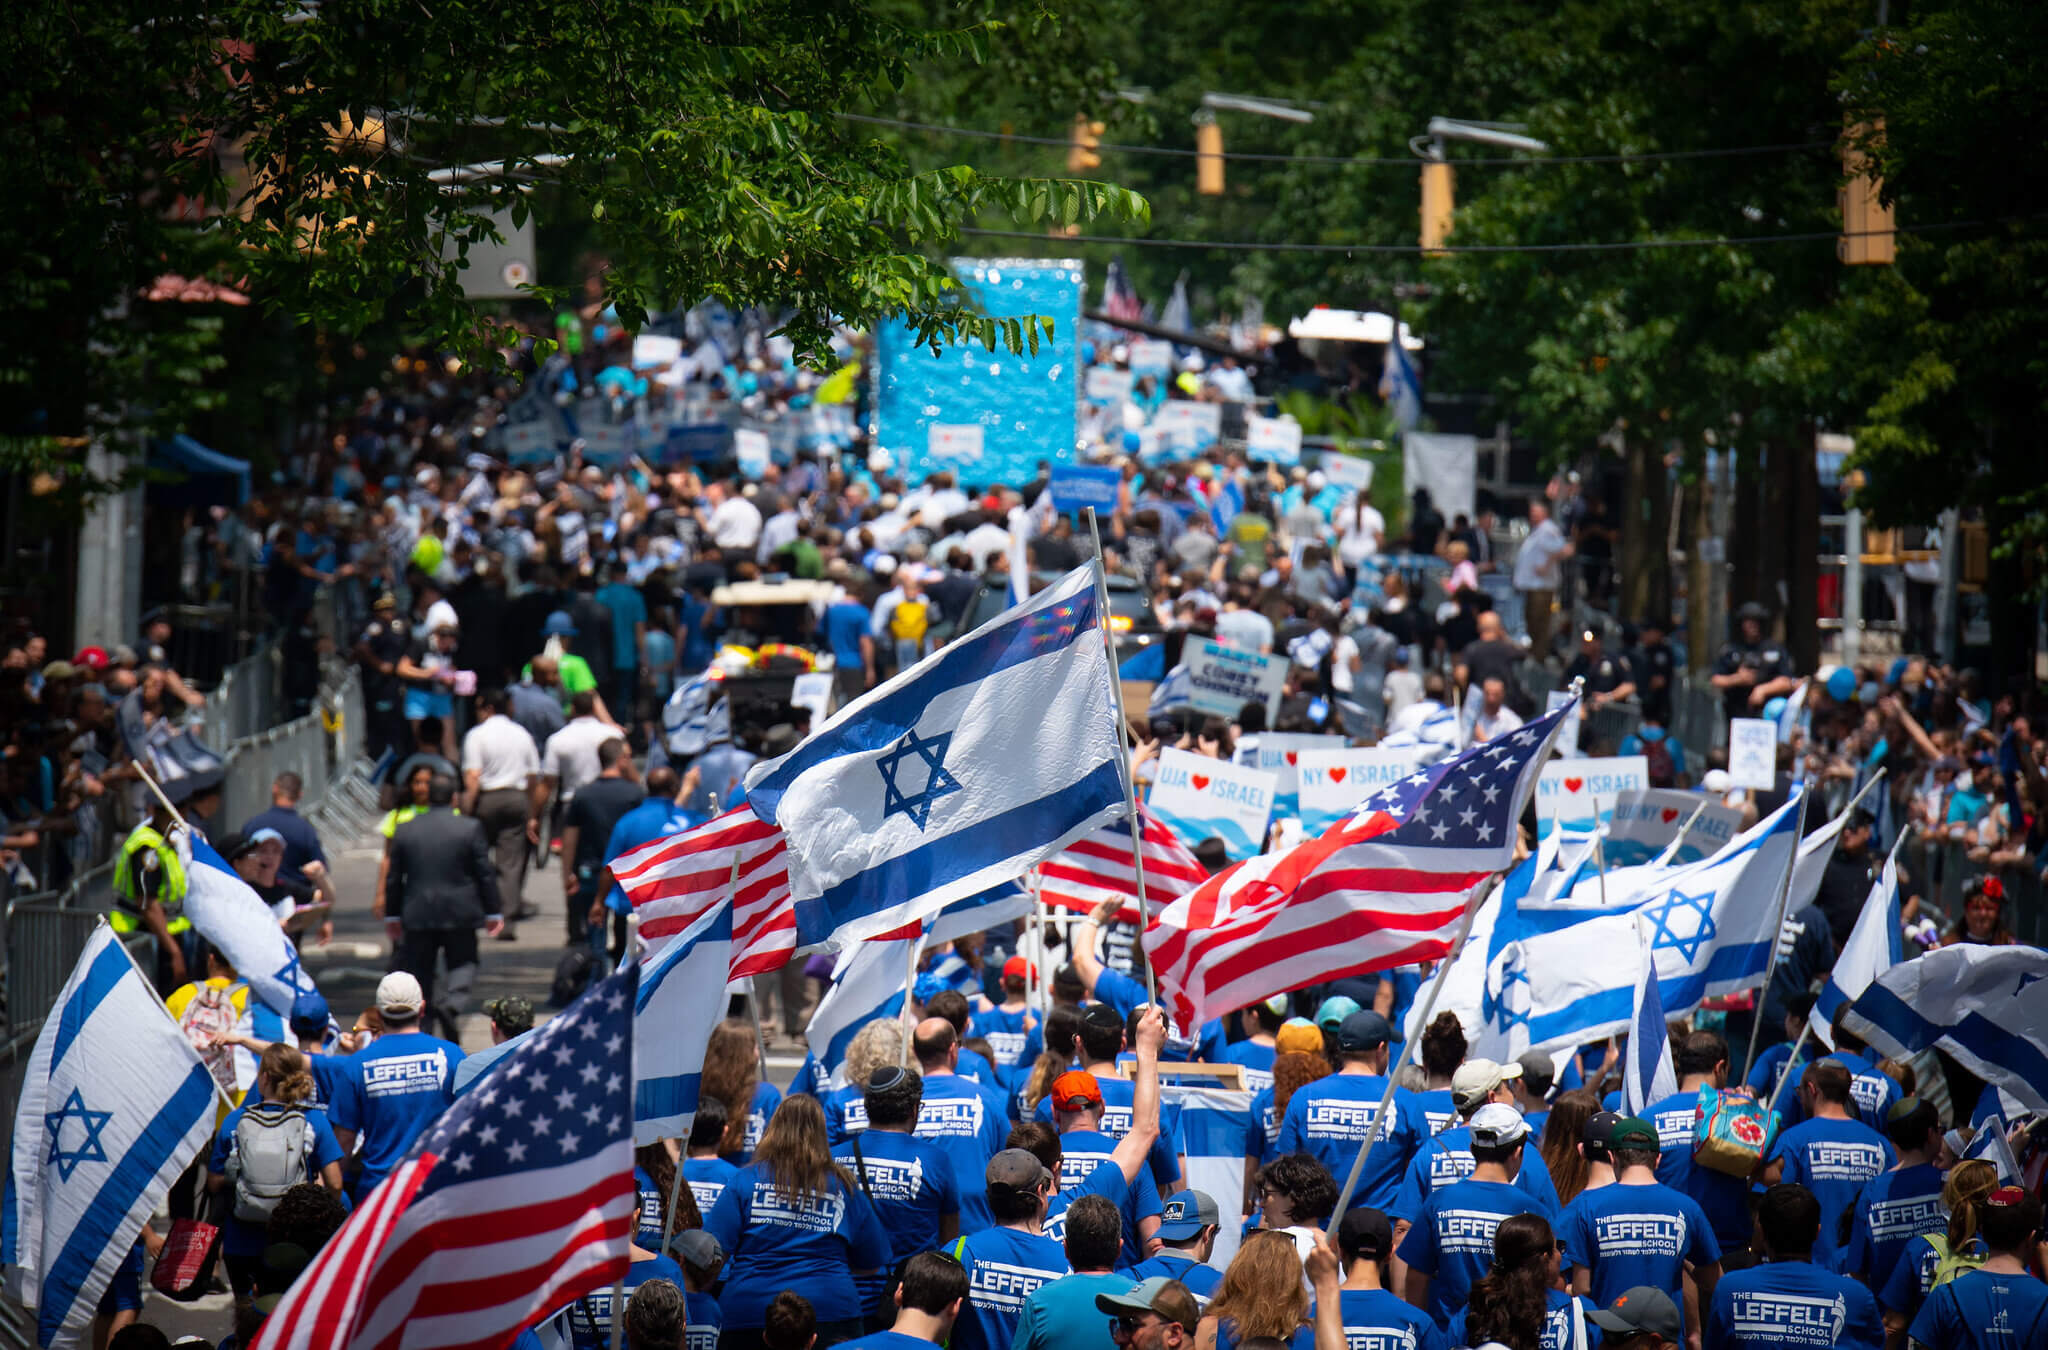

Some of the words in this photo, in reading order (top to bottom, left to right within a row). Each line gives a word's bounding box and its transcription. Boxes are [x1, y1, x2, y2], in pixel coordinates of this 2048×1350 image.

[1303, 768, 1323, 786] NY
[1160, 767, 1188, 789] UJA
[1210, 777, 1266, 809] ISRAEL
[1540, 778, 1559, 796] NY
[363, 1060, 438, 1084] LEFFELL
[918, 1104, 974, 1122] FFELL
[1350, 1126, 1384, 1134] SCHL
[1655, 1117, 1696, 1134] LEFF
[1809, 1149, 1878, 1168] LEFFELL
[1431, 1159, 1476, 1178] LEFF
[1849, 1167, 1877, 1176] SCHOOL
[751, 1190, 833, 1218] LEFFELL
[796, 1213, 832, 1226] SCHOOL
[1438, 1210, 1453, 1219] THE
[1595, 1216, 1612, 1225] THE
[1869, 1202, 1943, 1228] LEFFELL
[1914, 1218, 1946, 1229] SCHOOL
[1438, 1218, 1500, 1239] LEFFE
[1596, 1221, 1676, 1242] LEFFELL
[1642, 1240, 1676, 1249] SCHOOL
[974, 1260, 992, 1269] THE
[970, 1269, 1043, 1296] LEFFE
[1732, 1292, 1751, 1300] THE
[1733, 1302, 1833, 1327] LEFFELL
[1787, 1325, 1831, 1338] SCHOOL
